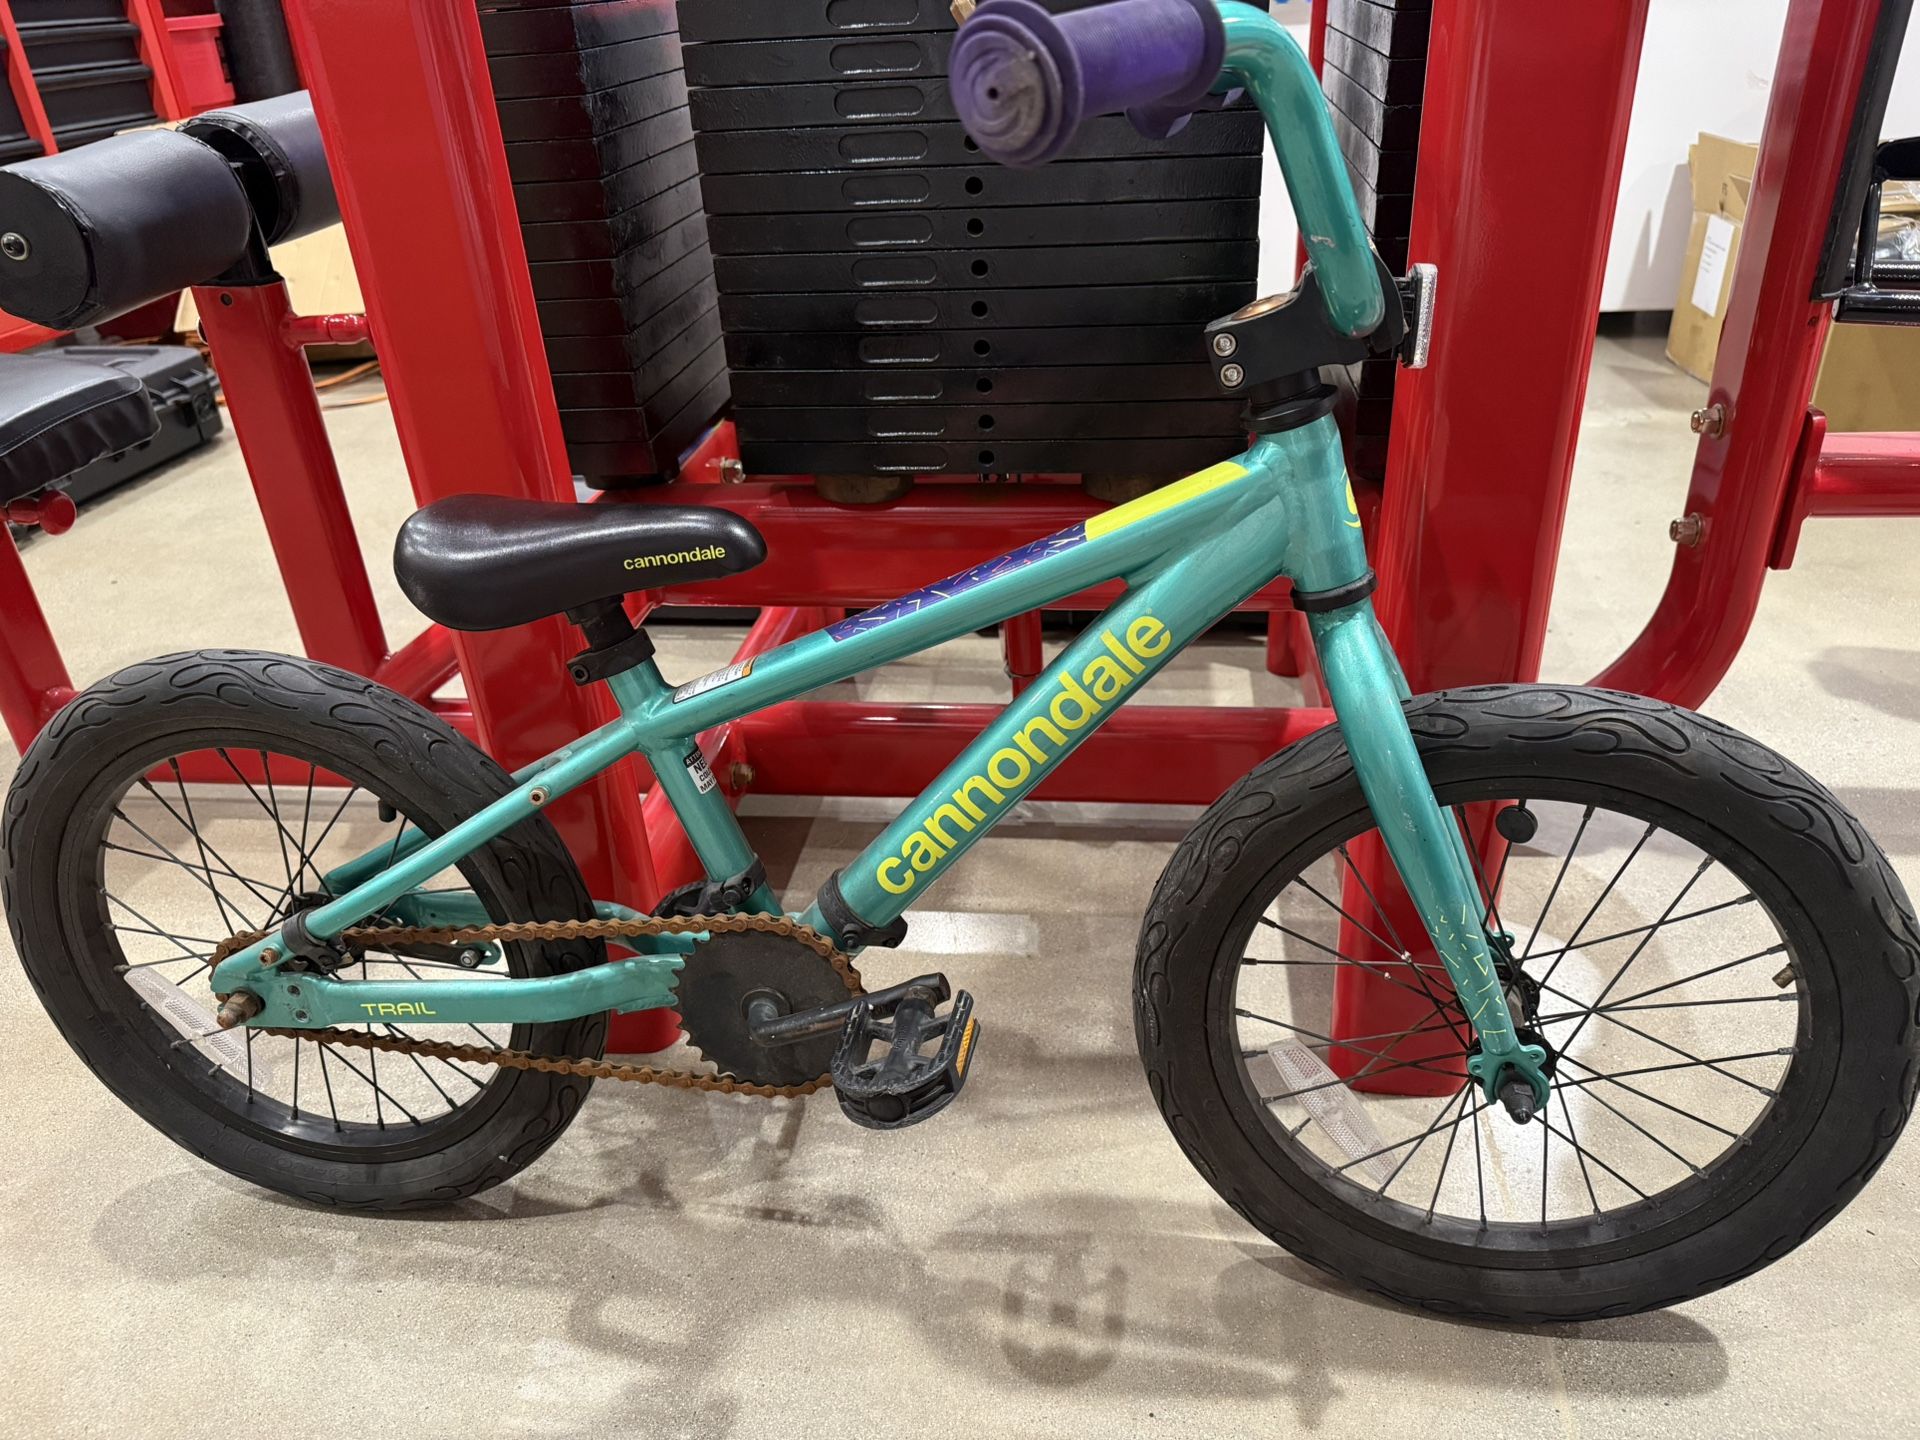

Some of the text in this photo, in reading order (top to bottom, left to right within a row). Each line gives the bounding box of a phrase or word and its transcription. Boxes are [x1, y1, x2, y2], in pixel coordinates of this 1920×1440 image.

[623, 545, 726, 570] cannondale
[876, 615, 1172, 894] cannondale
[360, 1002, 437, 1016] TRAIL
